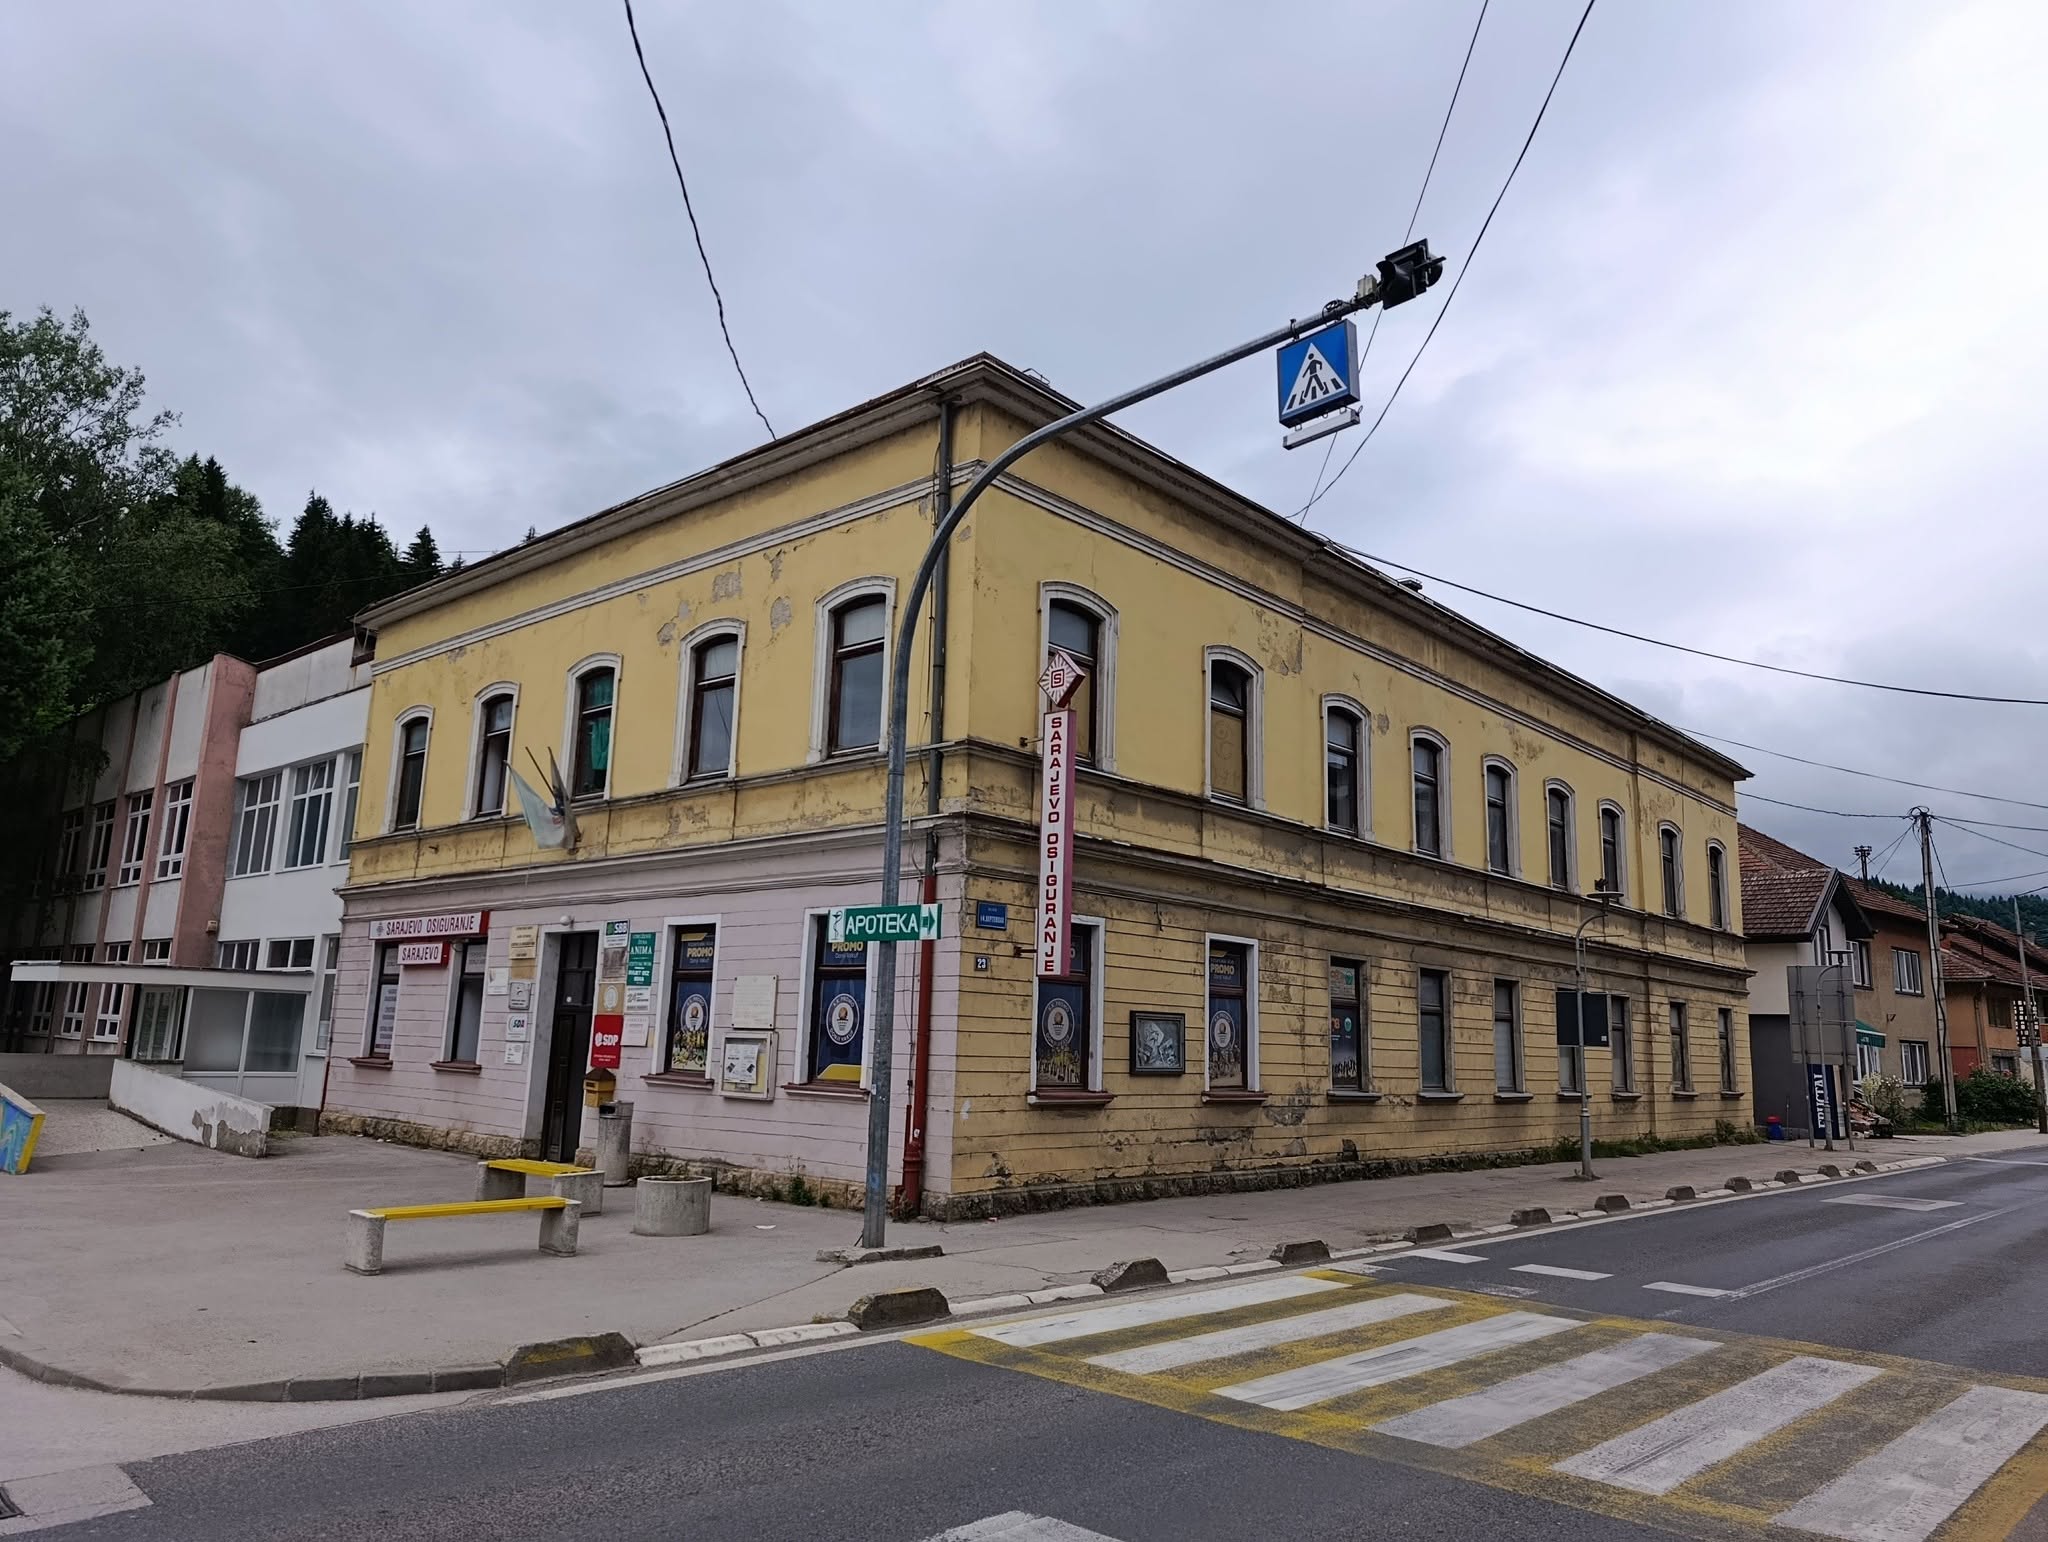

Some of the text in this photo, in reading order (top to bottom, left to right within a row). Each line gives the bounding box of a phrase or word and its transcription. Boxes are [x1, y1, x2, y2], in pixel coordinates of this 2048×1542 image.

[1043, 716, 1063, 972] SARAJEVO OSIGURANJE
[386, 916, 475, 936] SARAJEVO OSIGURANJE
[845, 913, 918, 935] APOTEKA
[630, 946, 653, 955] ANIMA
[687, 946, 714, 958] PROMO
[831, 941, 864, 952] PROMO
[401, 946, 439, 961] SARAJEVO
[977, 958, 987, 969] 23
[1210, 963, 1235, 975] PROMO
[602, 1034, 619, 1047] SDP
